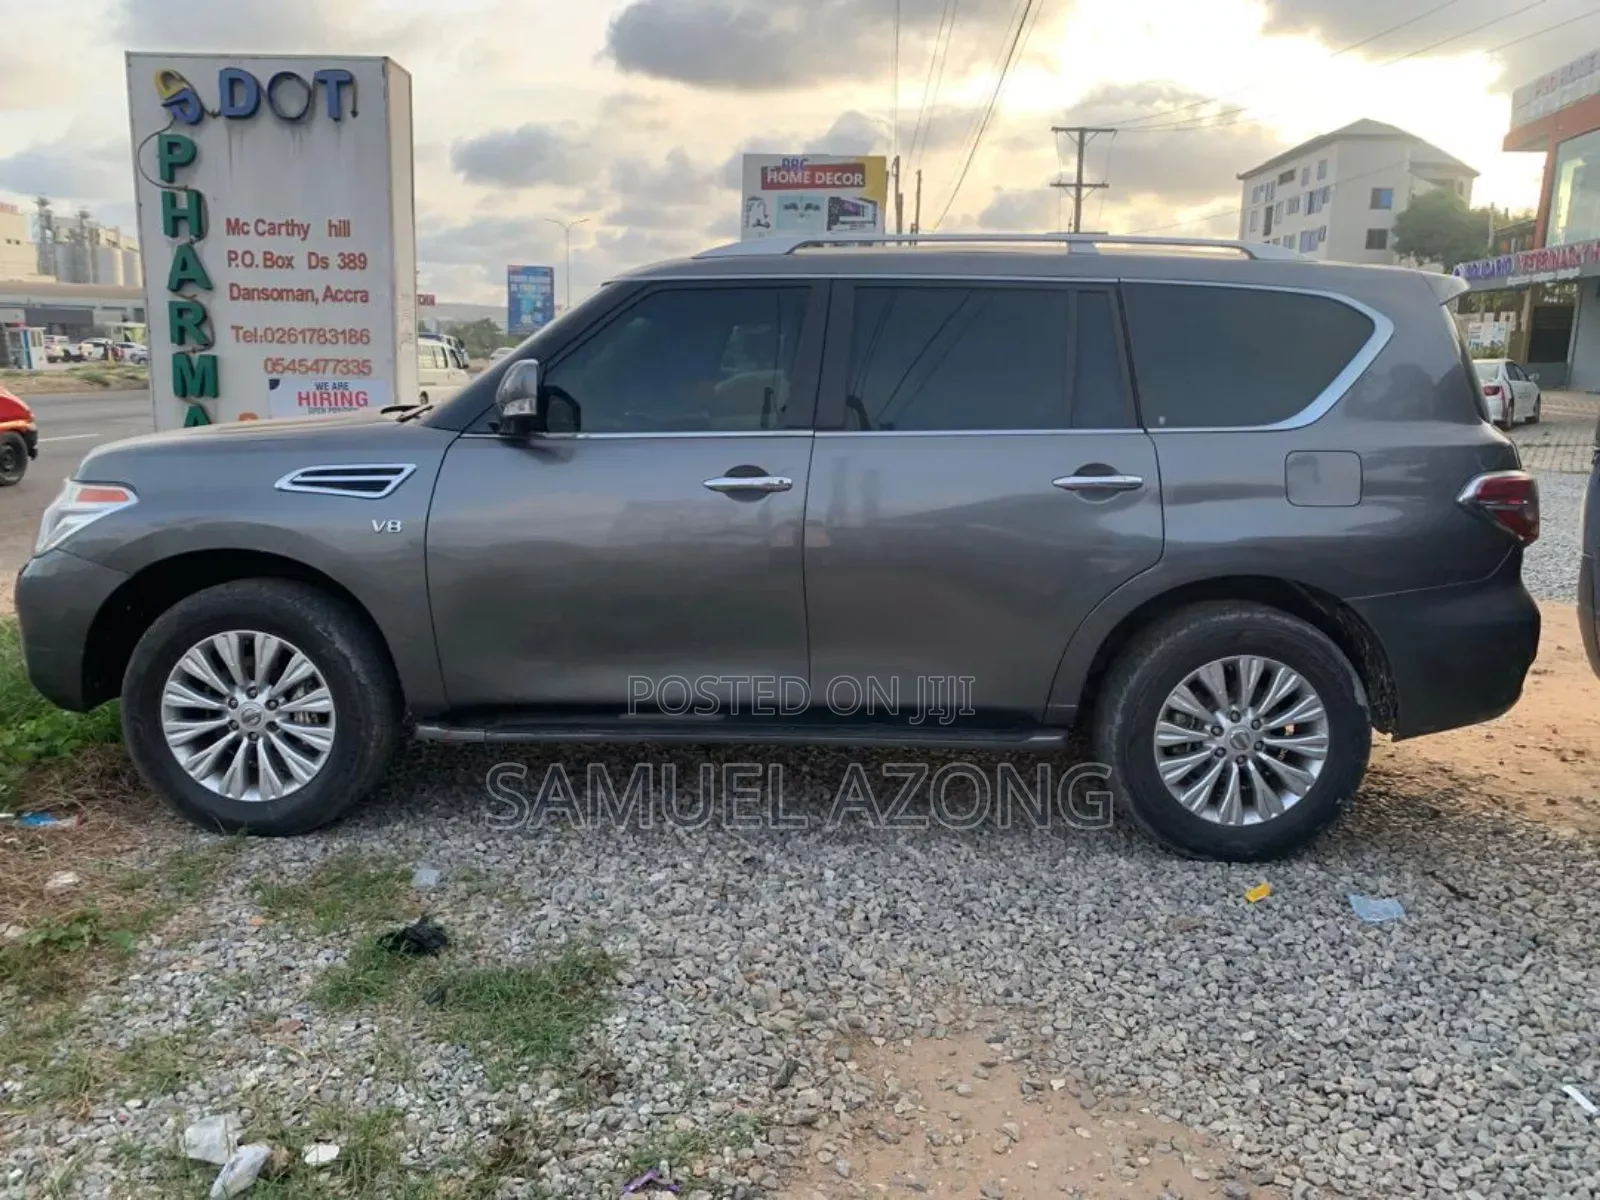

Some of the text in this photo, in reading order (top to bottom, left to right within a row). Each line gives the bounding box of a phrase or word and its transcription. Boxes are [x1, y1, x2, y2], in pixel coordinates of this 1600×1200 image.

[767, 169, 864, 185] HOME DECOR
[226, 217, 351, 241] Mc Carthy hill
[263, 251, 294, 269] Box
[307, 252, 329, 269] Ds
[337, 252, 367, 270] 389
[264, 357, 373, 376] 0545477335
[314, 381, 349, 391] WE ARE
[298, 391, 369, 407] HIRING
[371, 519, 401, 533] V8
